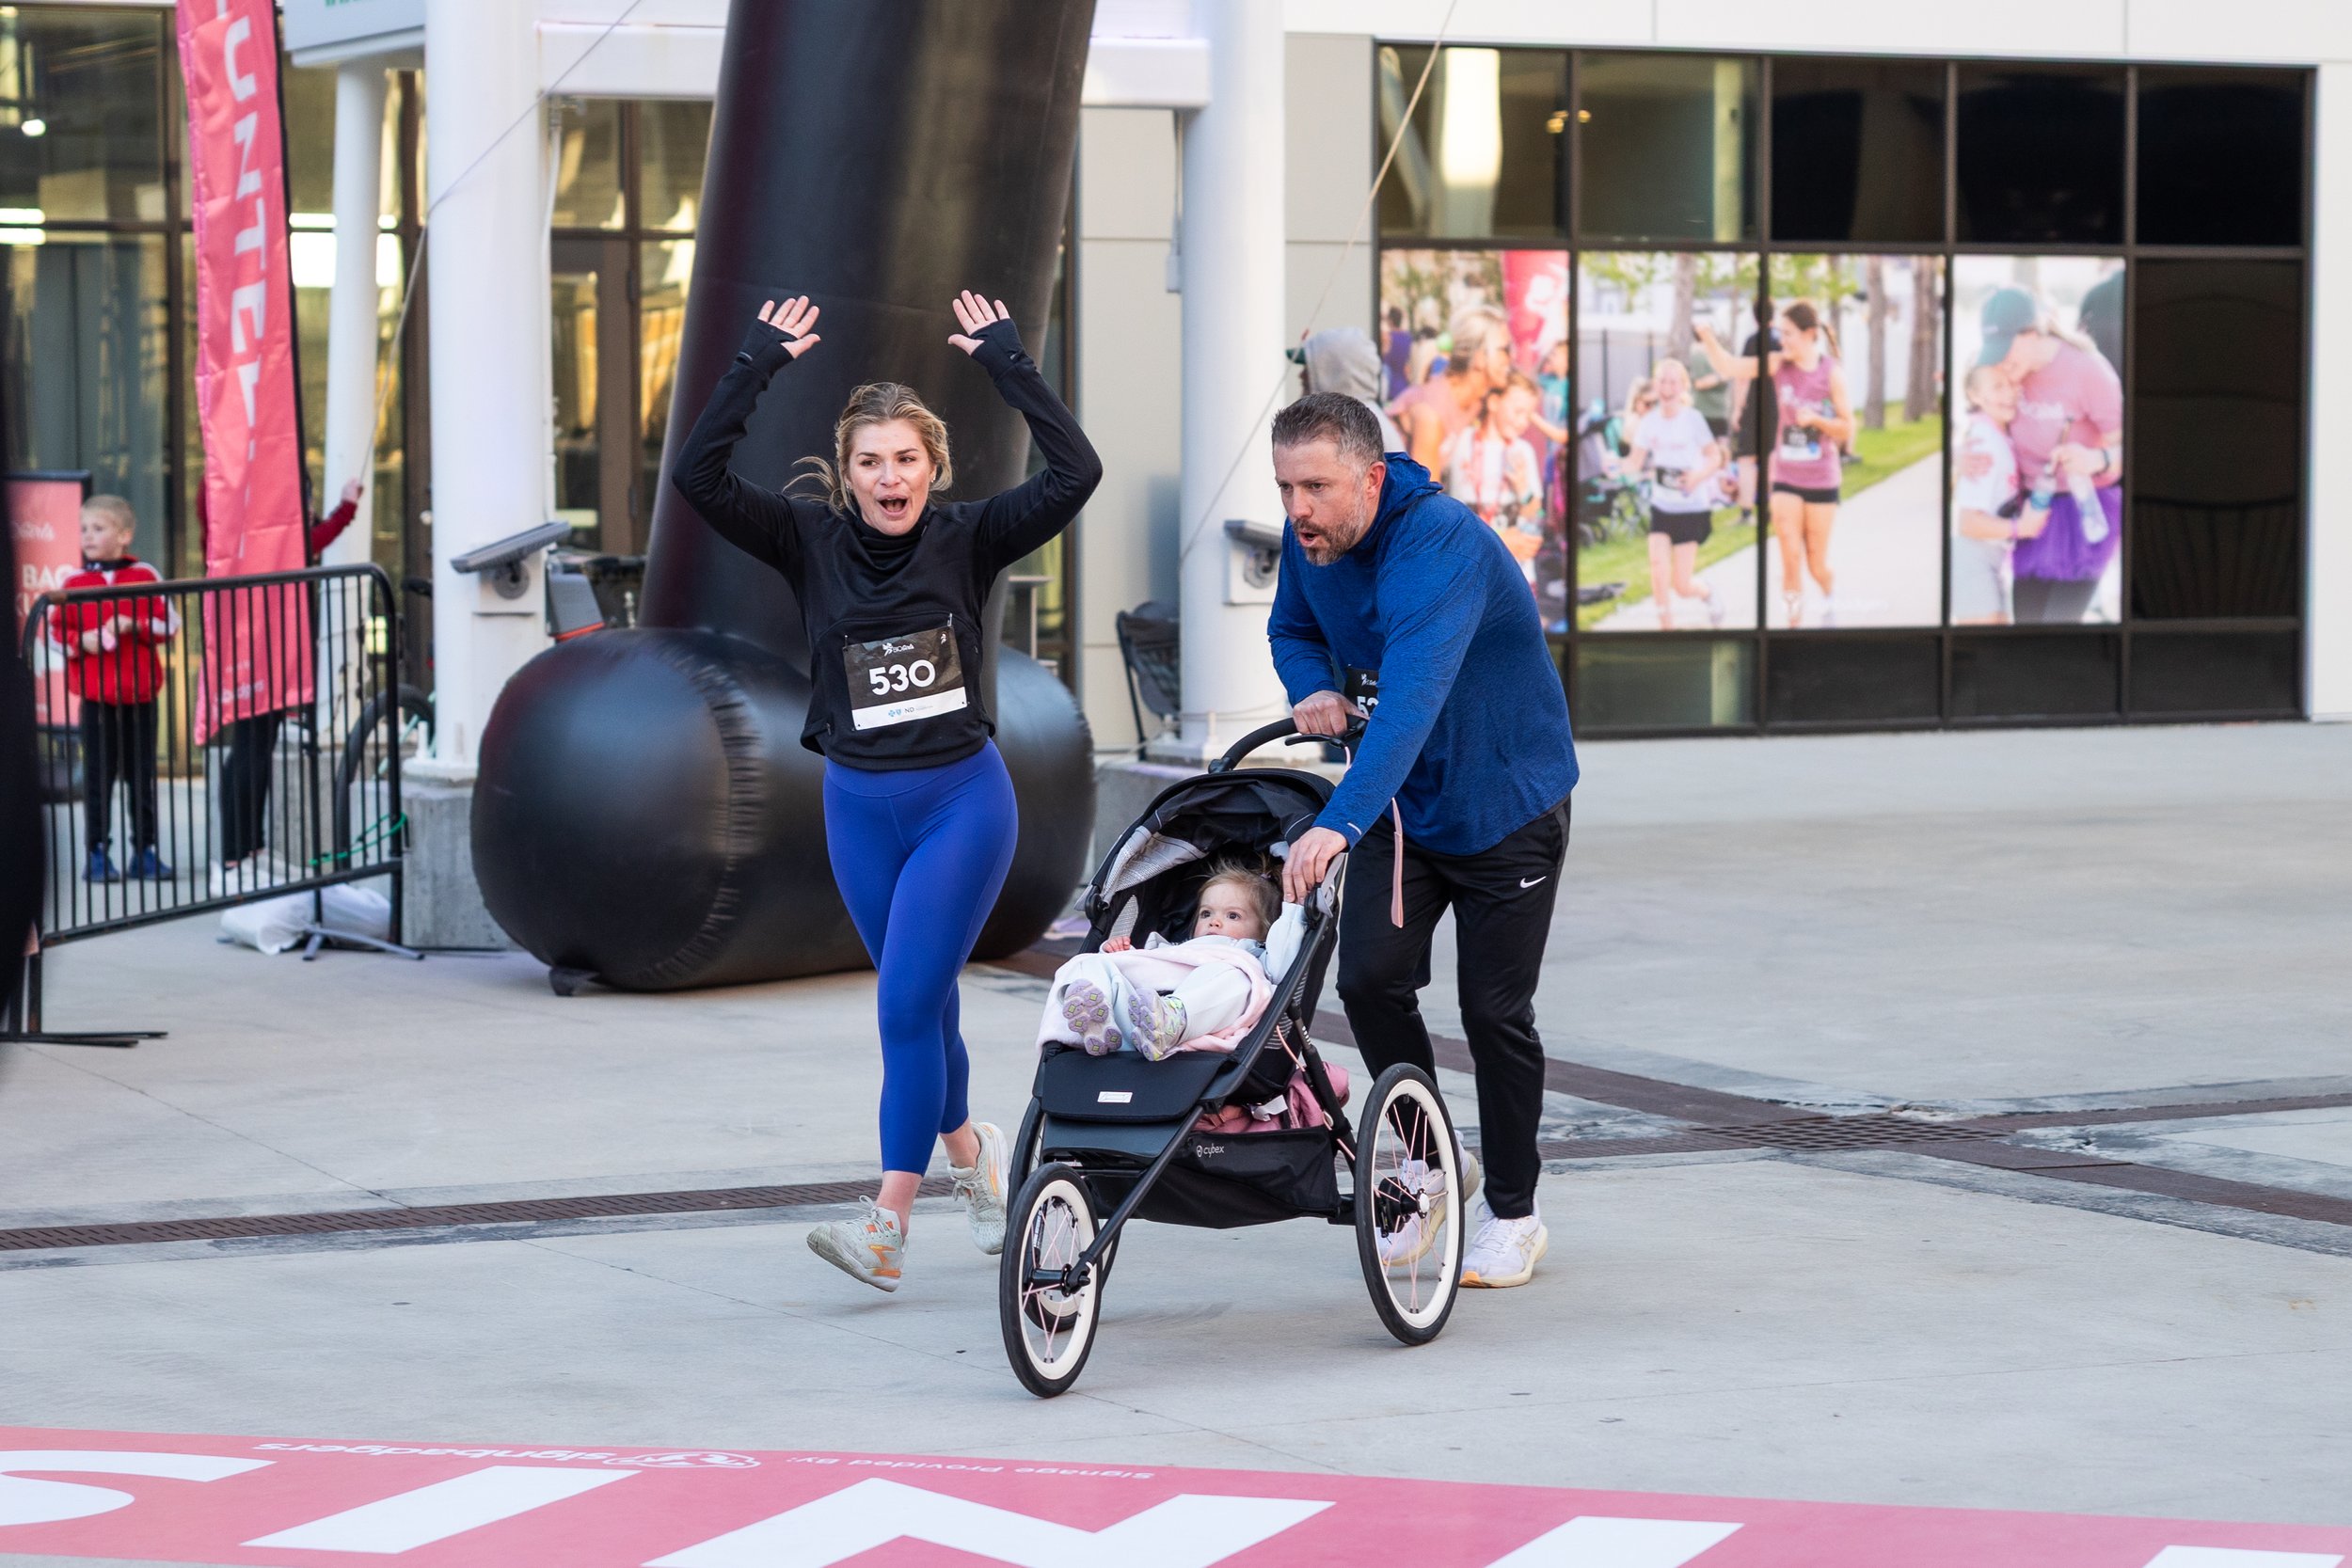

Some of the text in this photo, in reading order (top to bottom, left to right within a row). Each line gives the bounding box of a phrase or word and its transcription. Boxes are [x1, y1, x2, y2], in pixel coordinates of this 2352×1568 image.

[869, 660, 935, 695] 530
[1203, 1143, 1225, 1158] cybex
[255, 1442, 616, 1463] signbadgers
[848, 1458, 1004, 1474] Provided
[1015, 1466, 1155, 1480] Signage
